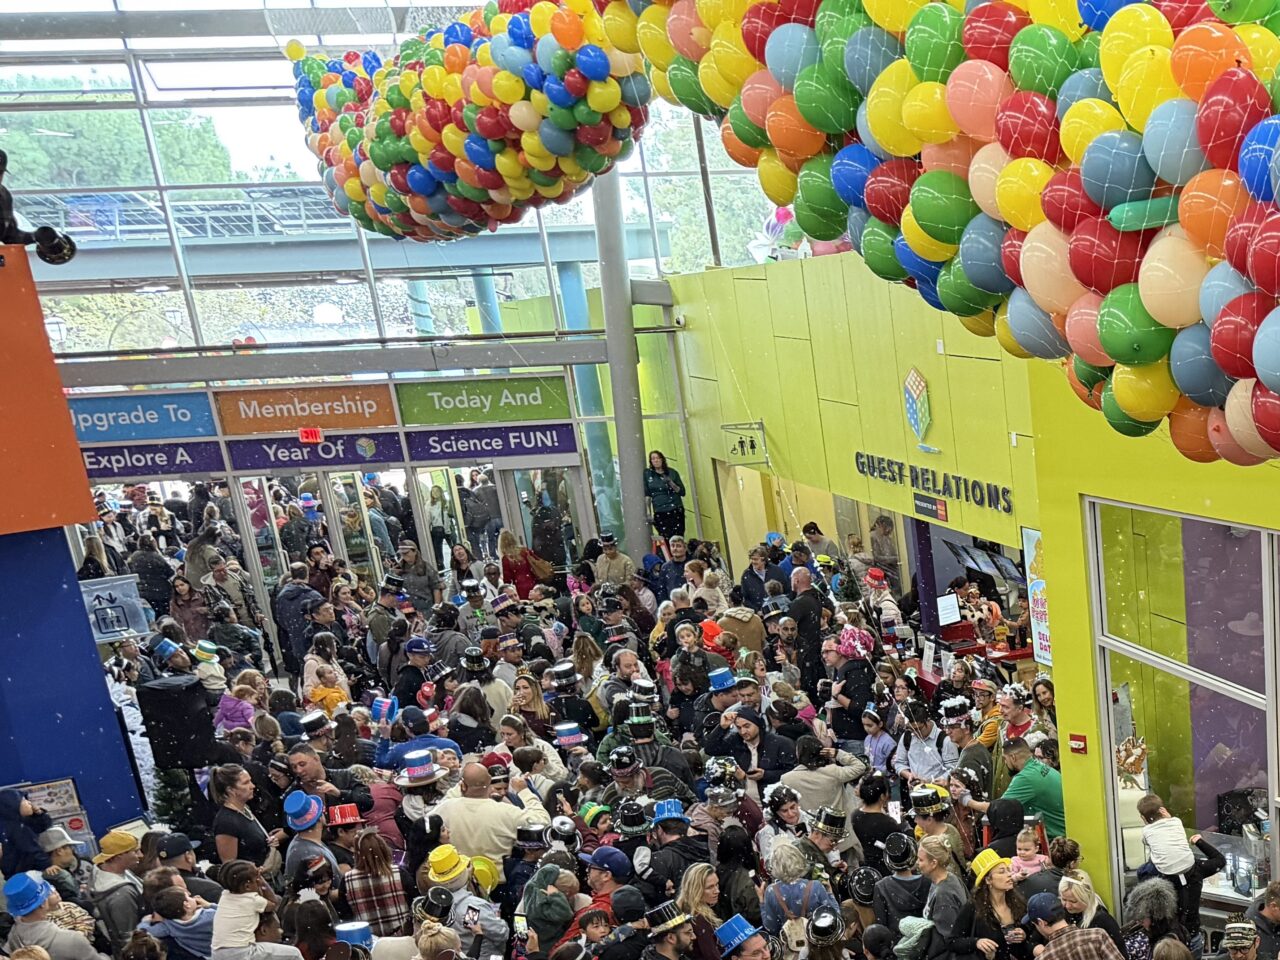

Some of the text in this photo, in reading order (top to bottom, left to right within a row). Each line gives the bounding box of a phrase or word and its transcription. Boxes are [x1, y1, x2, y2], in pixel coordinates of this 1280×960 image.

[238, 396, 377, 419] Membership
[428, 386, 542, 412] Today And
[164, 404, 192, 422] To
[262, 439, 345, 462] Year Of
[428, 430, 559, 454] Science FUN!
[83, 446, 192, 472] Explore A
[855, 451, 1013, 514] GUEST RELATIONS
